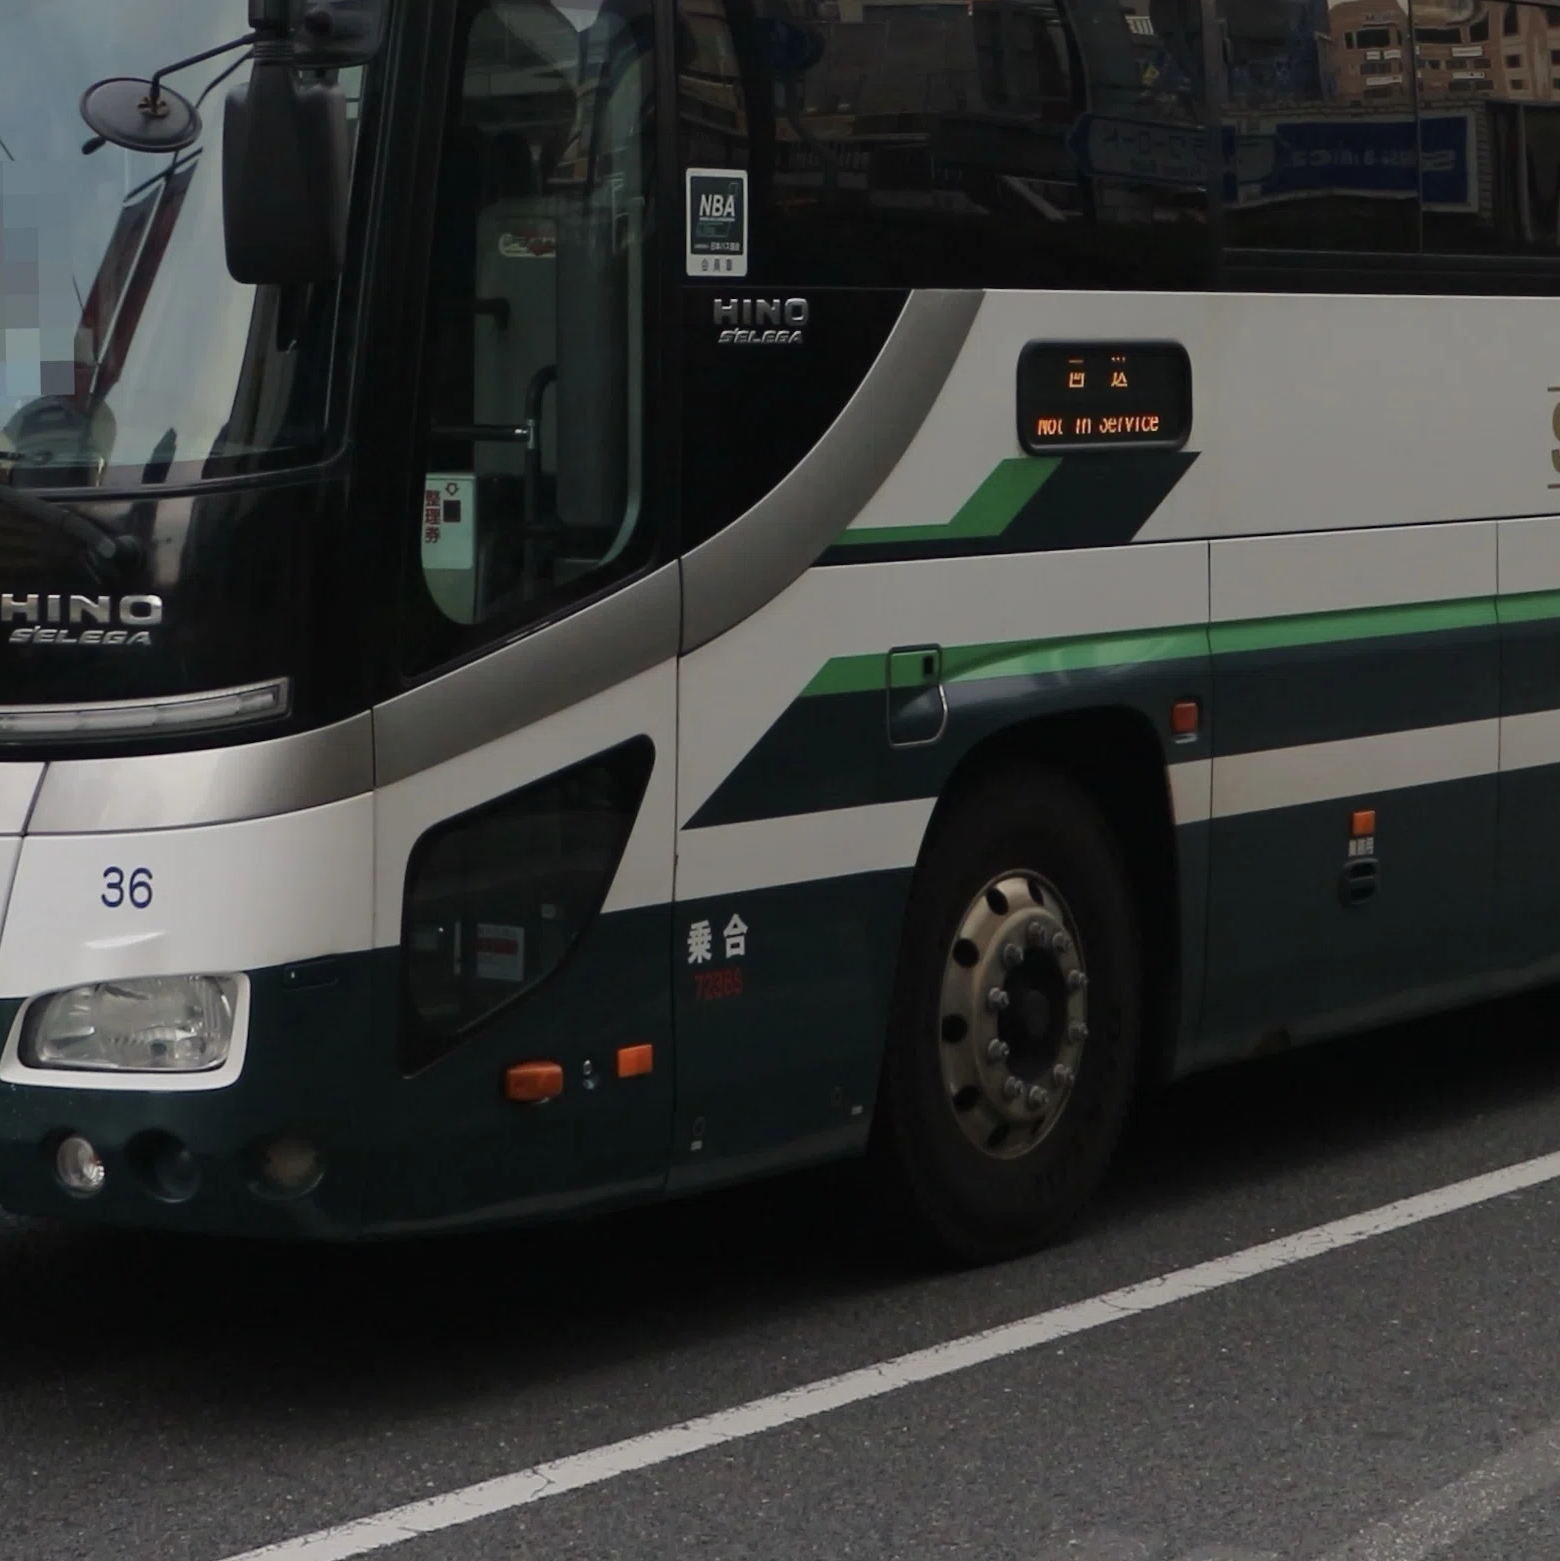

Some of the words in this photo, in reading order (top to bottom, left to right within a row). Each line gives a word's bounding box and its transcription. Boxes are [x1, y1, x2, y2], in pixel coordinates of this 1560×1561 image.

[699, 194, 736, 217] NBA
[713, 298, 809, 326] HINO
[1, 593, 163, 625] HINO
[101, 866, 153, 909] 36
[687, 913, 749, 964] 乗合
